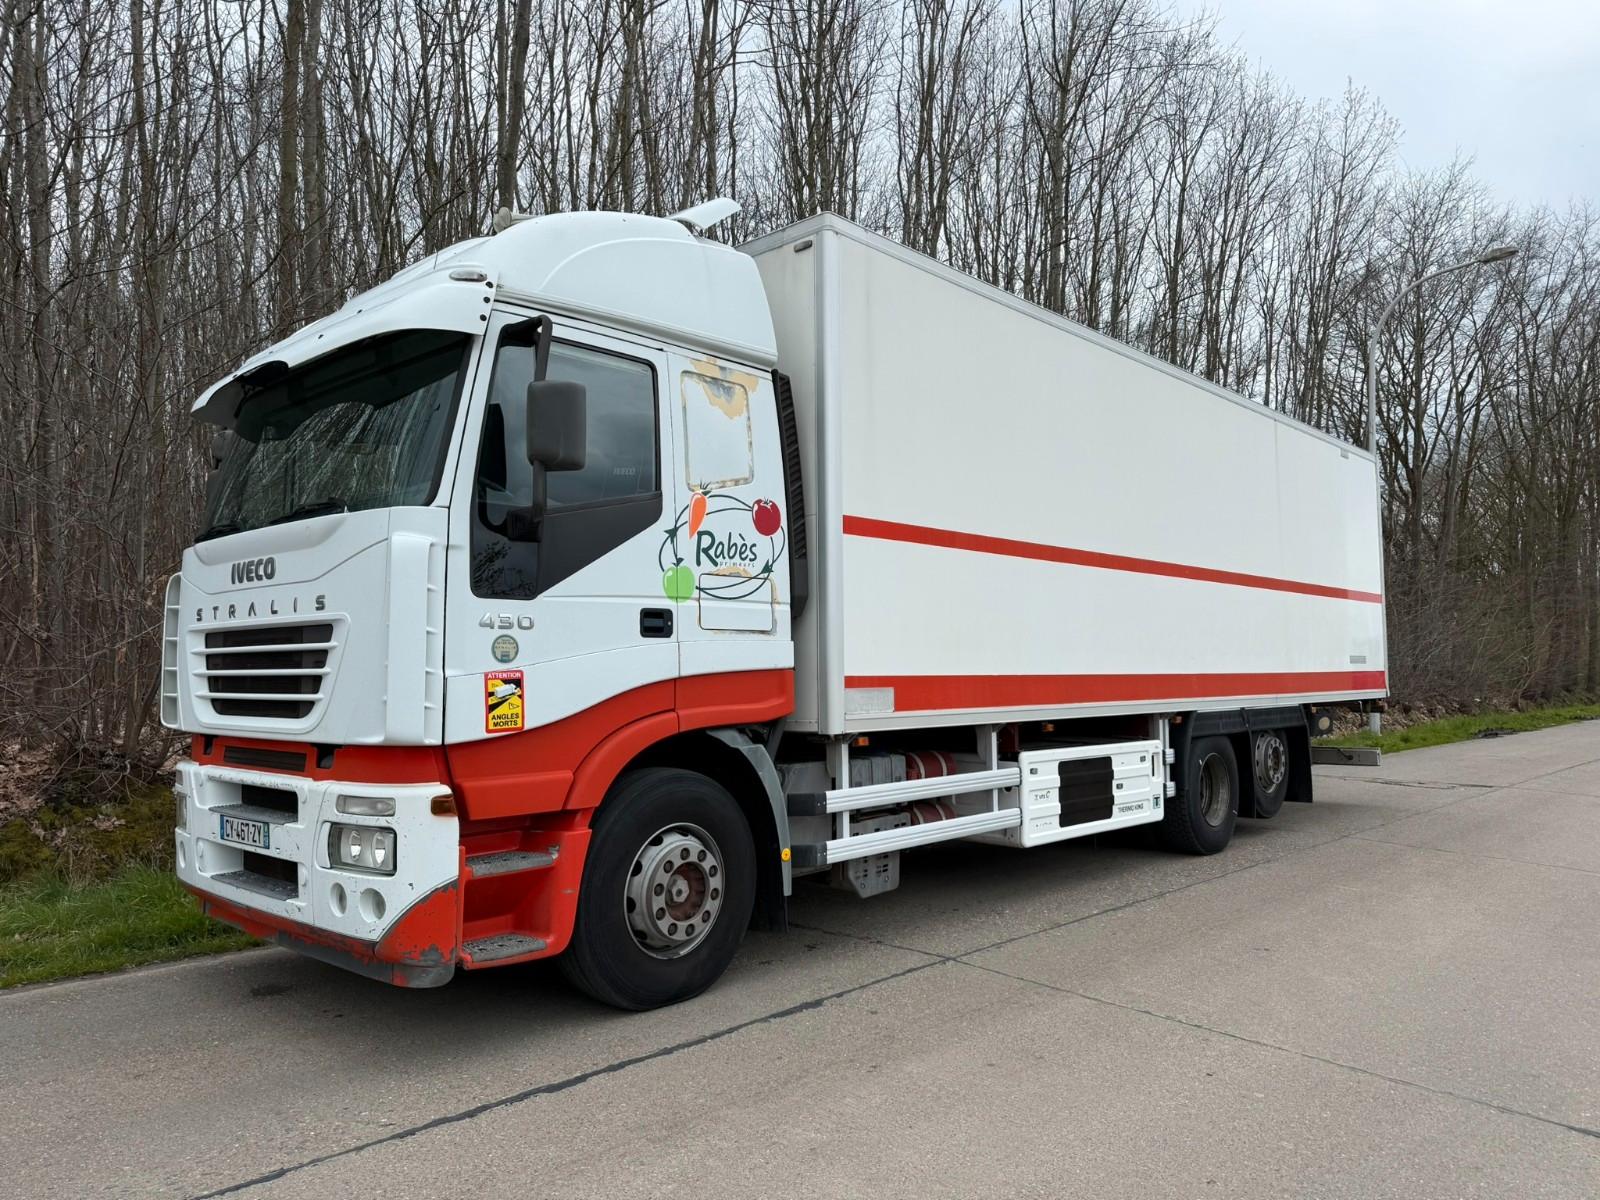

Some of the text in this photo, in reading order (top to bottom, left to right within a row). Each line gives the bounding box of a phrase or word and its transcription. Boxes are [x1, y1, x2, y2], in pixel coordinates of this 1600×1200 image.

[695, 530, 758, 567] Rabès
[231, 556, 276, 585] IVECO
[196, 594, 326, 622] STRALIS
[478, 612, 535, 630] 430
[487, 671, 521, 679] ATTENTION
[491, 713, 520, 721] ANGLES
[492, 720, 519, 728] MORTS
